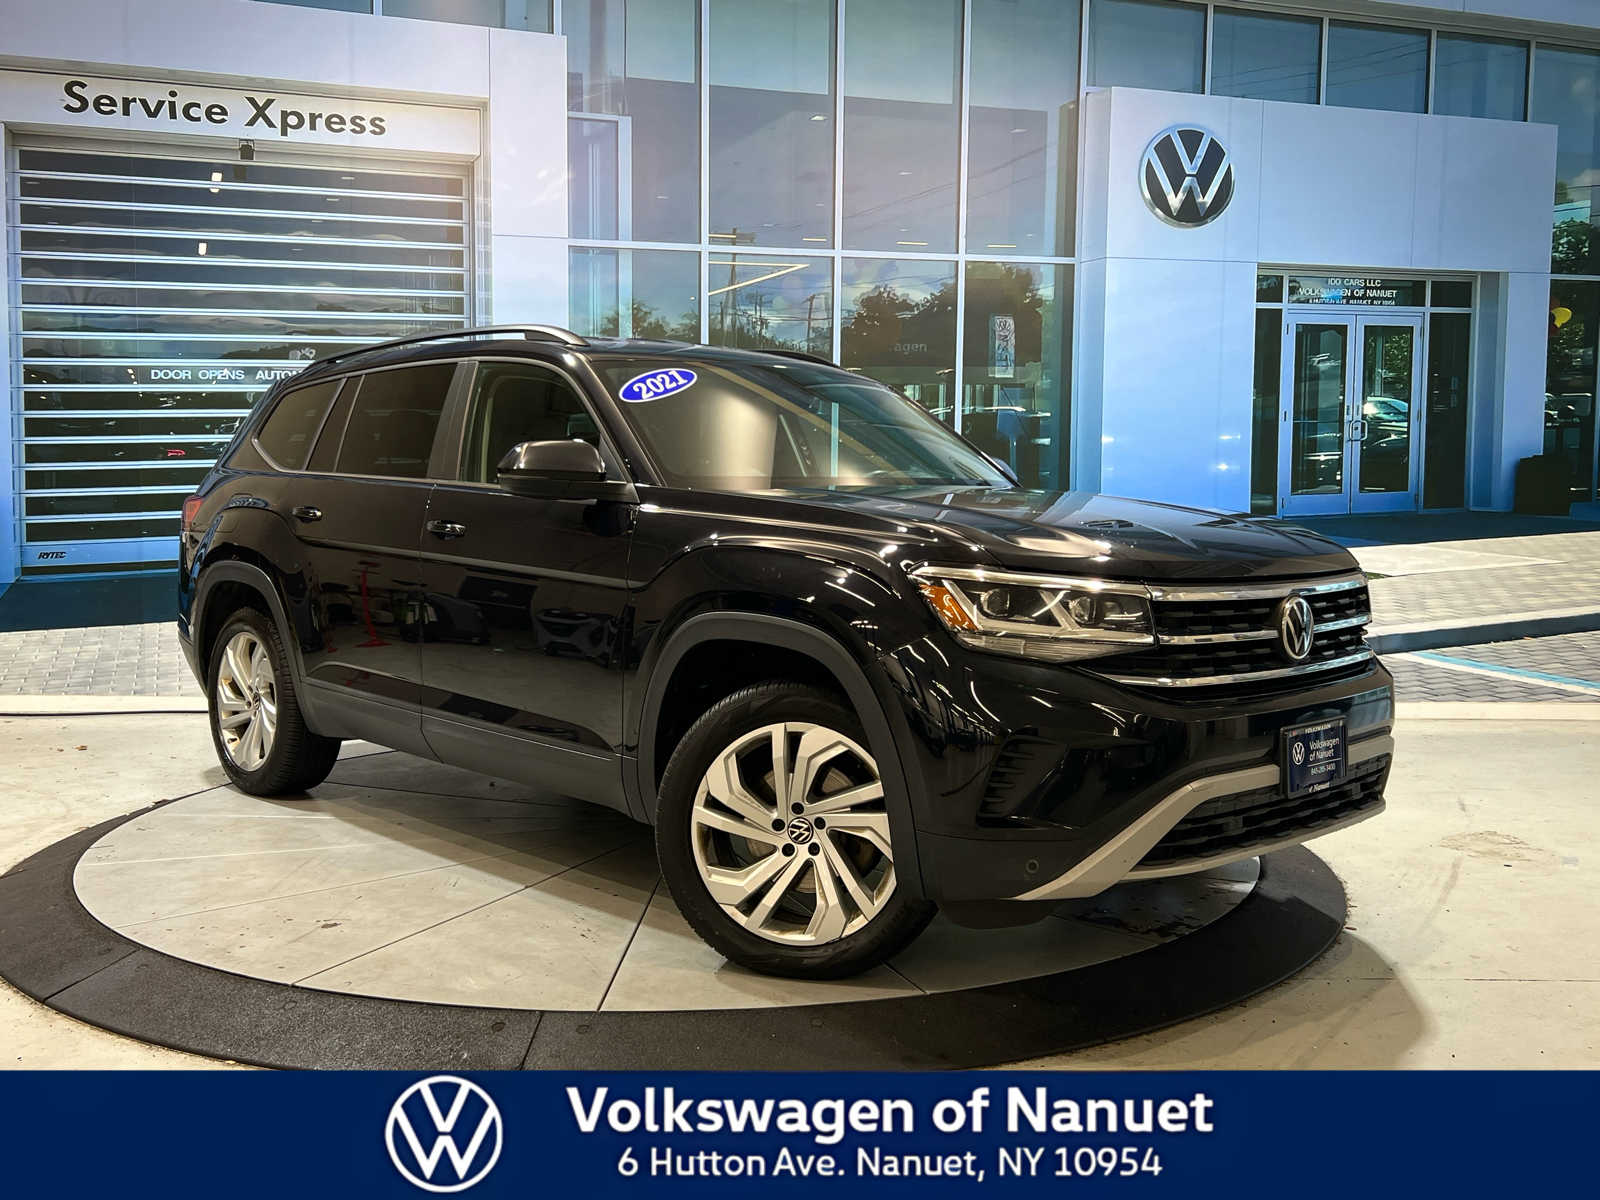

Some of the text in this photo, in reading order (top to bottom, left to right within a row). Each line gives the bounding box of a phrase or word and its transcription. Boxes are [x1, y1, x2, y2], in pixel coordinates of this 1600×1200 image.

[63, 80, 386, 137] Service Xpress
[1344, 279, 1365, 287] CARS
[1366, 279, 1381, 287] LLC
[1353, 289, 1365, 297] OF
[1366, 289, 1397, 298] NANUET
[151, 369, 191, 380] DOOR
[198, 369, 245, 380] OPENS
[632, 370, 688, 400] 2021
[1309, 737, 1340, 750] Volkswagen
[1309, 749, 1334, 761] of Nanuet
